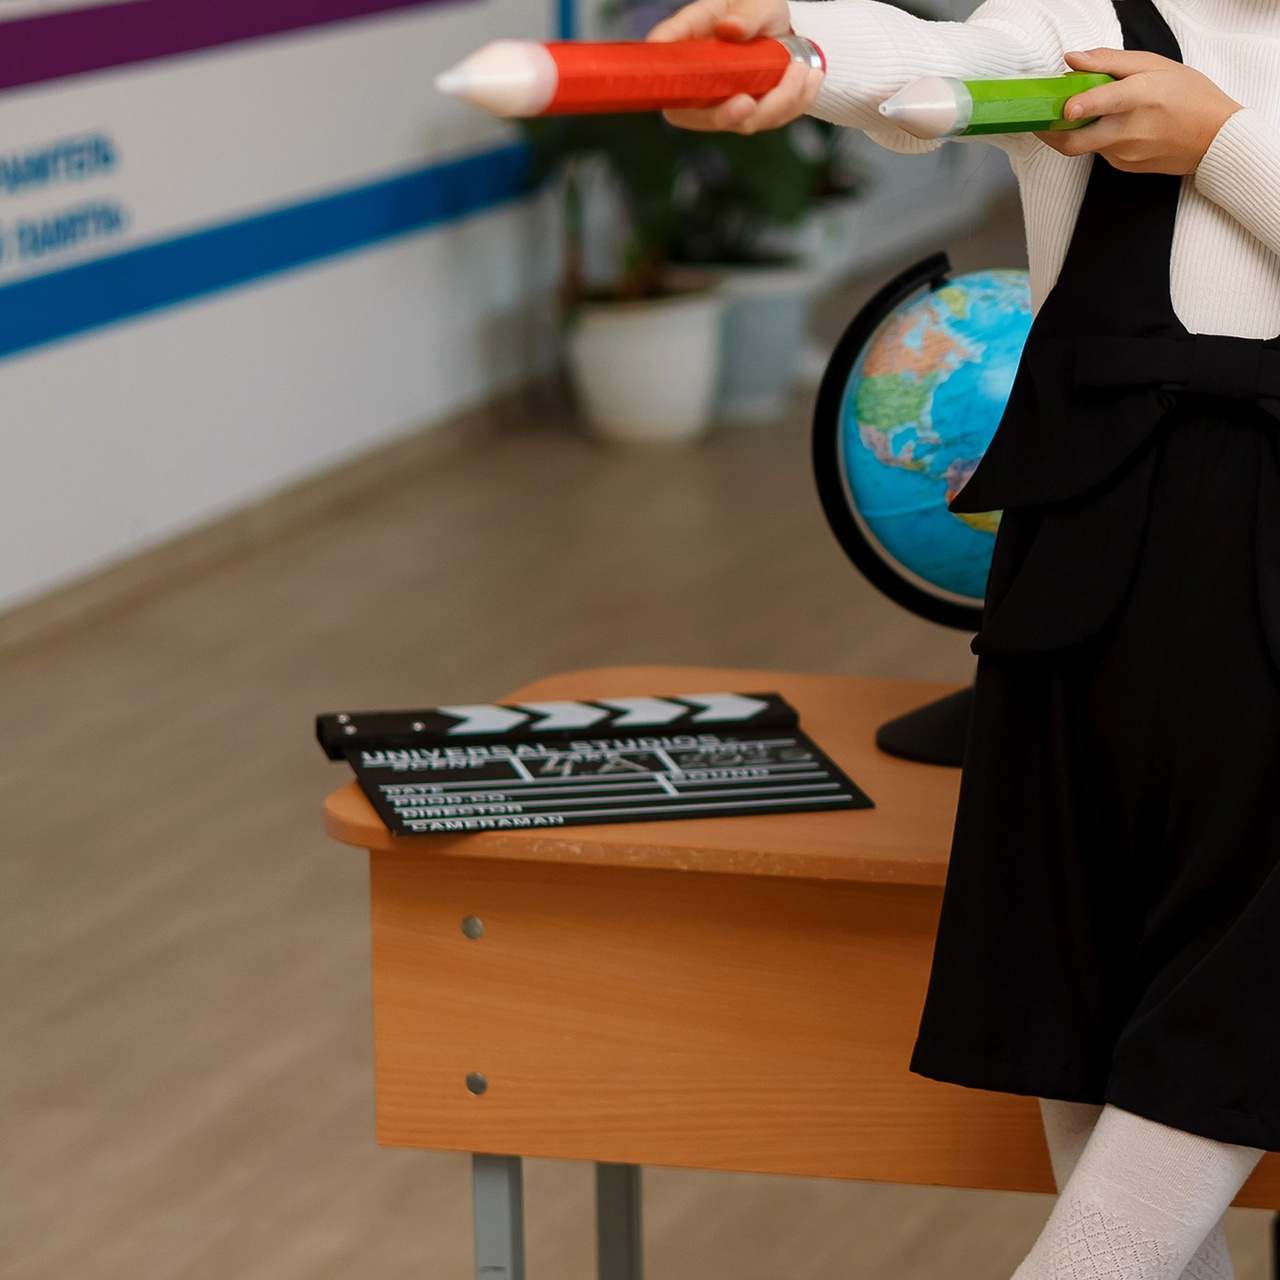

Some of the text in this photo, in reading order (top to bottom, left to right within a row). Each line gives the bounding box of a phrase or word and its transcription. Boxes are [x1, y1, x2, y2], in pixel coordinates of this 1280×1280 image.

[361, 735, 721, 762] UNIVERSAL STUDIOS
[385, 786, 443, 795] DATE
[402, 804, 523, 818] DIRECTOR
[412, 816, 564, 832] CAMERAMAN
